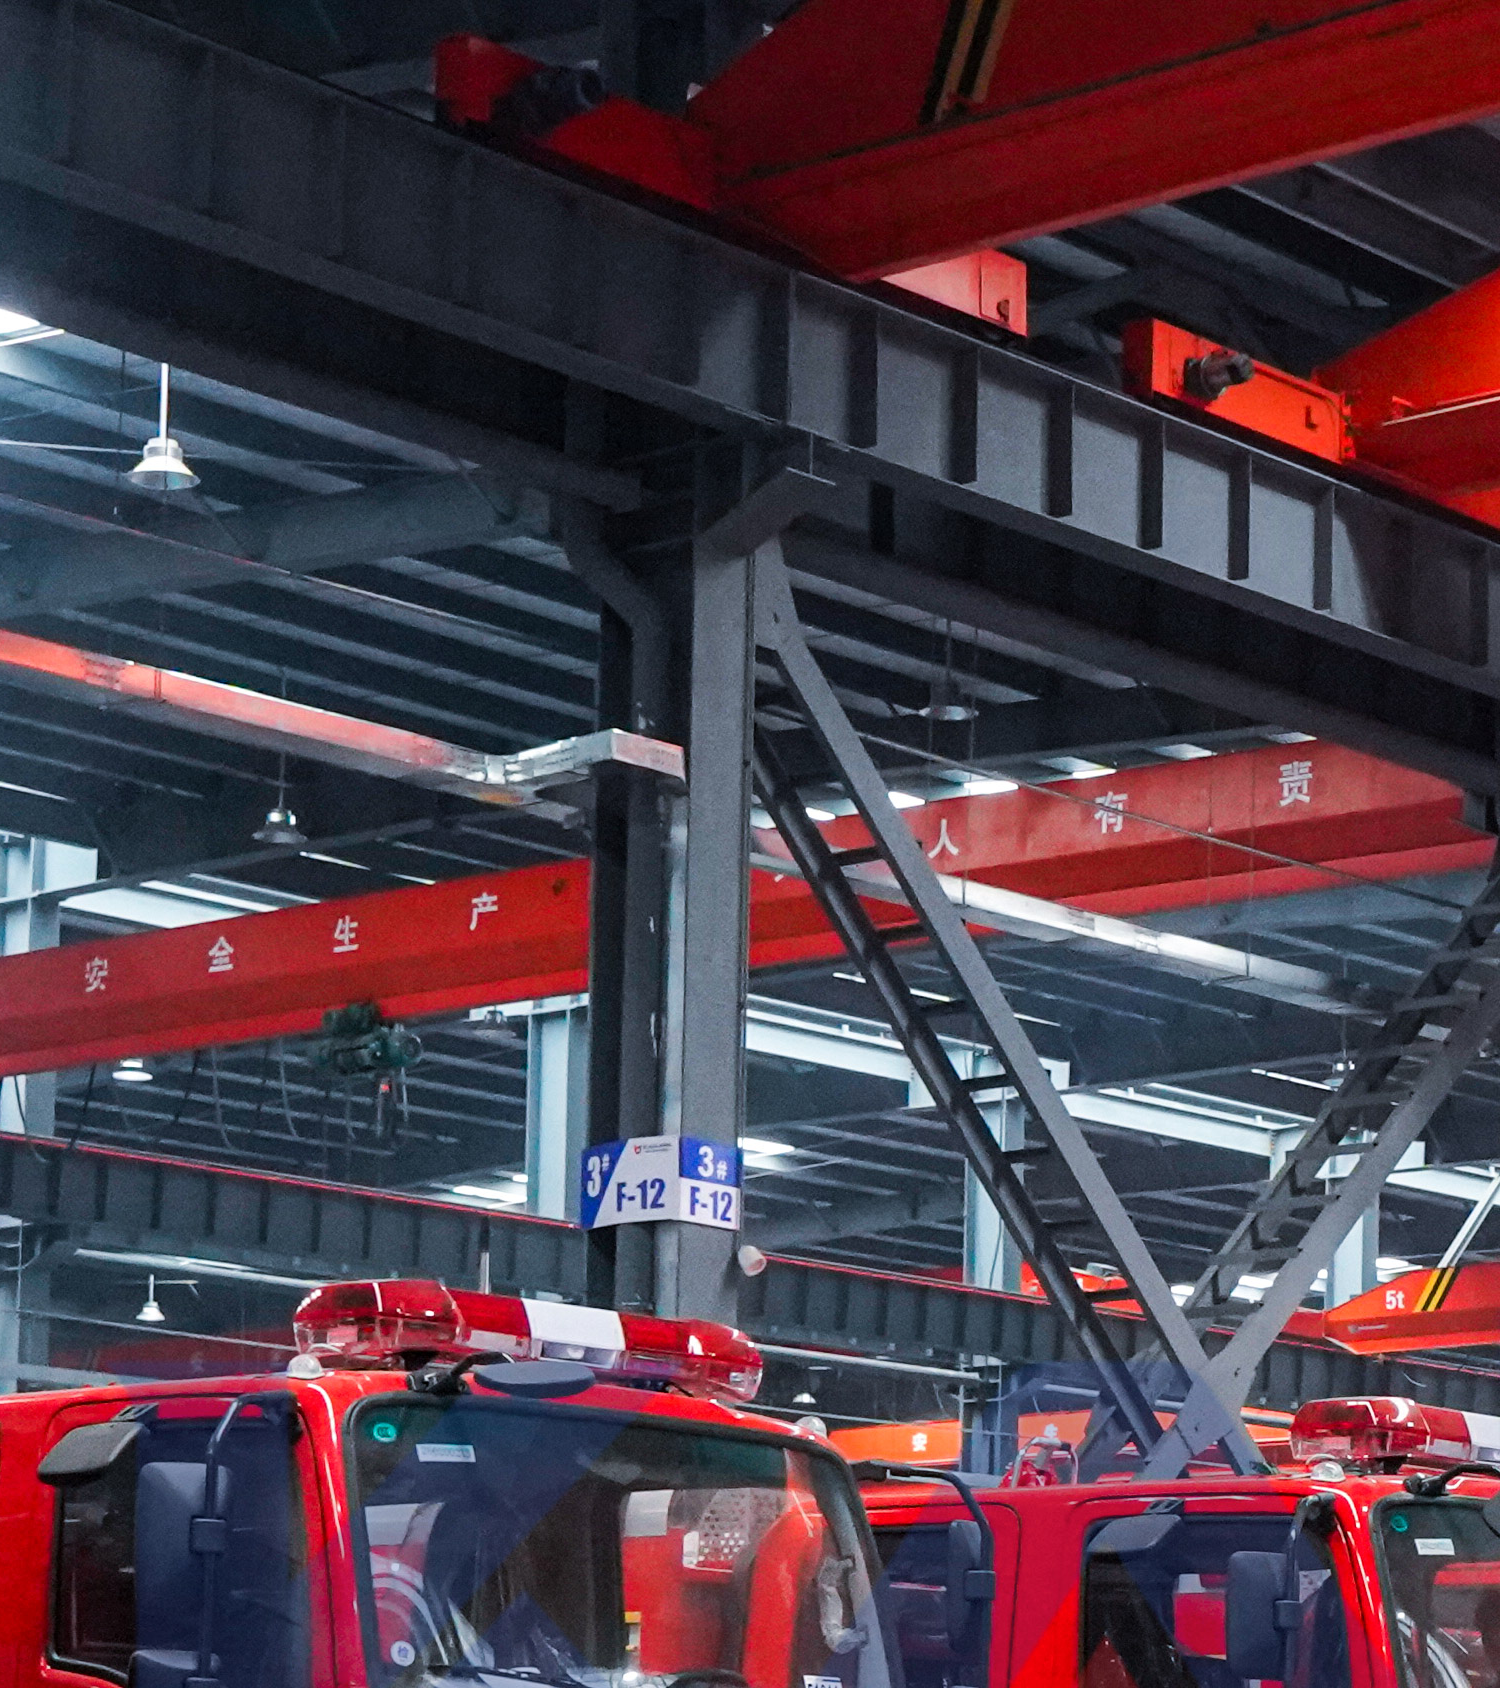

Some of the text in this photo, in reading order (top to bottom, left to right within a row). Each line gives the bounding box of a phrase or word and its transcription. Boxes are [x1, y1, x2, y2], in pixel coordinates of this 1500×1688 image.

[84, 892, 499, 993] 安全生产
[586, 1153, 610, 1198] 3#
[697, 1145, 728, 1181] 3#
[616, 1178, 666, 1212] F-12
[690, 1186, 732, 1222] F-12
[1385, 1290, 1405, 1310] 5t
